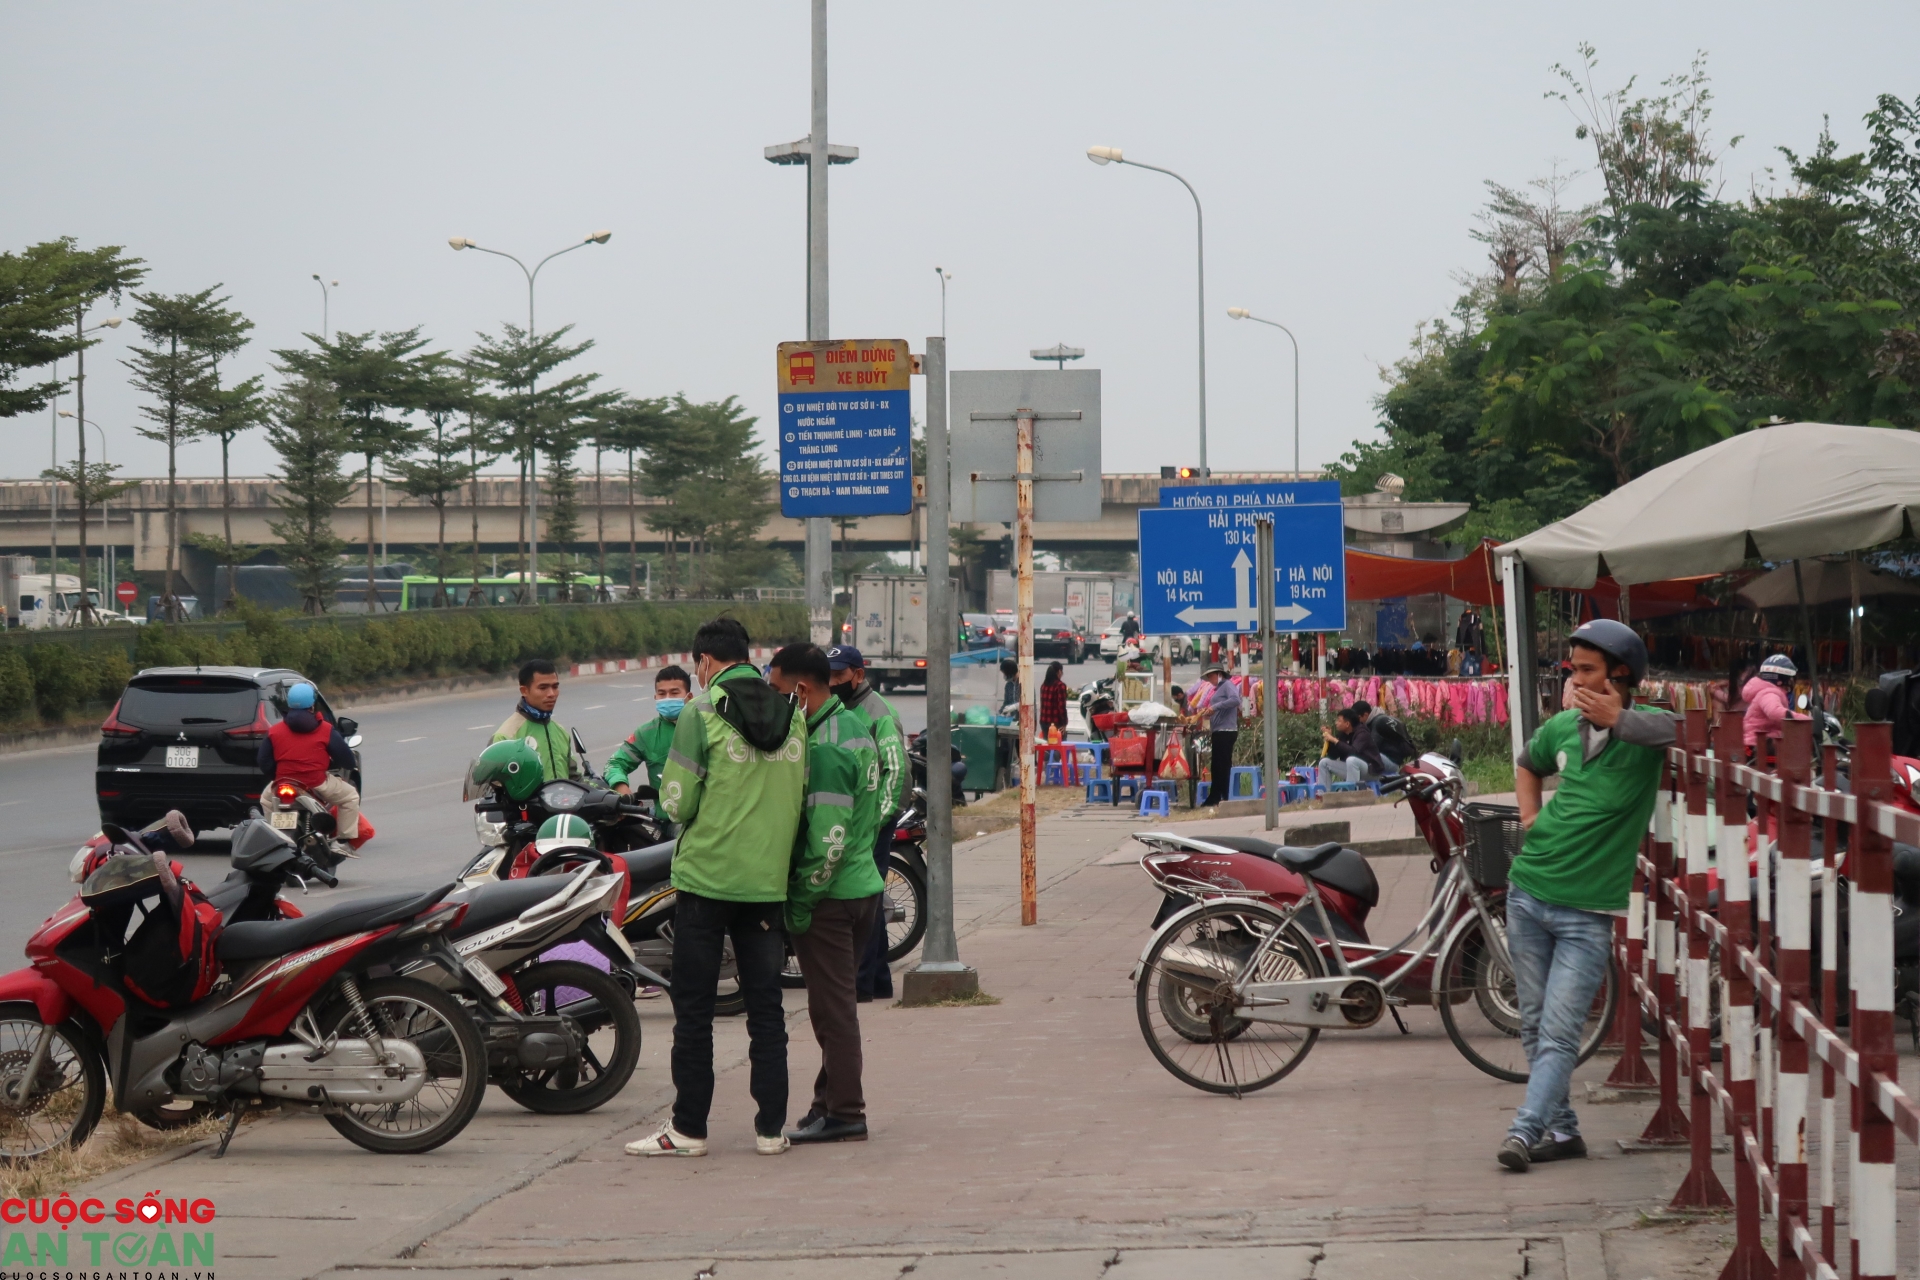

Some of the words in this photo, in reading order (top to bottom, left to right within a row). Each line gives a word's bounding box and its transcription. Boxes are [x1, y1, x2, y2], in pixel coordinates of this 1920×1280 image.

[826, 344, 857, 363] ĐIỂM
[862, 346, 896, 363] DỪNG
[837, 371, 852, 384] XE
[857, 368, 887, 384] BUÝT
[796, 403, 805, 412] BV
[806, 401, 825, 413] NHIỆT
[838, 402, 848, 410] TW
[849, 401, 859, 410] CƠ
[869, 401, 875, 409] II
[880, 401, 889, 409] BX
[845, 430, 863, 438] LINH)
[868, 428, 882, 437] KCN
[821, 445, 838, 454] LONG
[797, 461, 803, 469] BV
[843, 459, 851, 467] TW
[874, 458, 882, 466] BX
[880, 471, 893, 479] TIMES
[893, 471, 904, 479] CITY
[801, 487, 820, 498] THẠCH
[836, 487, 850, 495] NAM
[873, 486, 889, 494] LONG
[1216, 495, 1227, 506] ĐI
[1233, 490, 1261, 506] PHÍA
[1266, 493, 1294, 505] NAM
[1209, 509, 1228, 528] HẢI
[1224, 530, 1239, 545] 130
[1157, 568, 1176, 587] NỘI
[1184, 568, 1203, 585] BÀI
[1290, 565, 1306, 581] HÀ
[1313, 563, 1333, 583] NỘI
[1166, 588, 1176, 602] 14
[1180, 588, 1203, 602] km
[1290, 584, 1299, 599] 19
[1302, 584, 1326, 599] km
[879, 733, 899, 746] Grab
[174, 747, 191, 756] 30G
[811, 825, 846, 886] Grab
